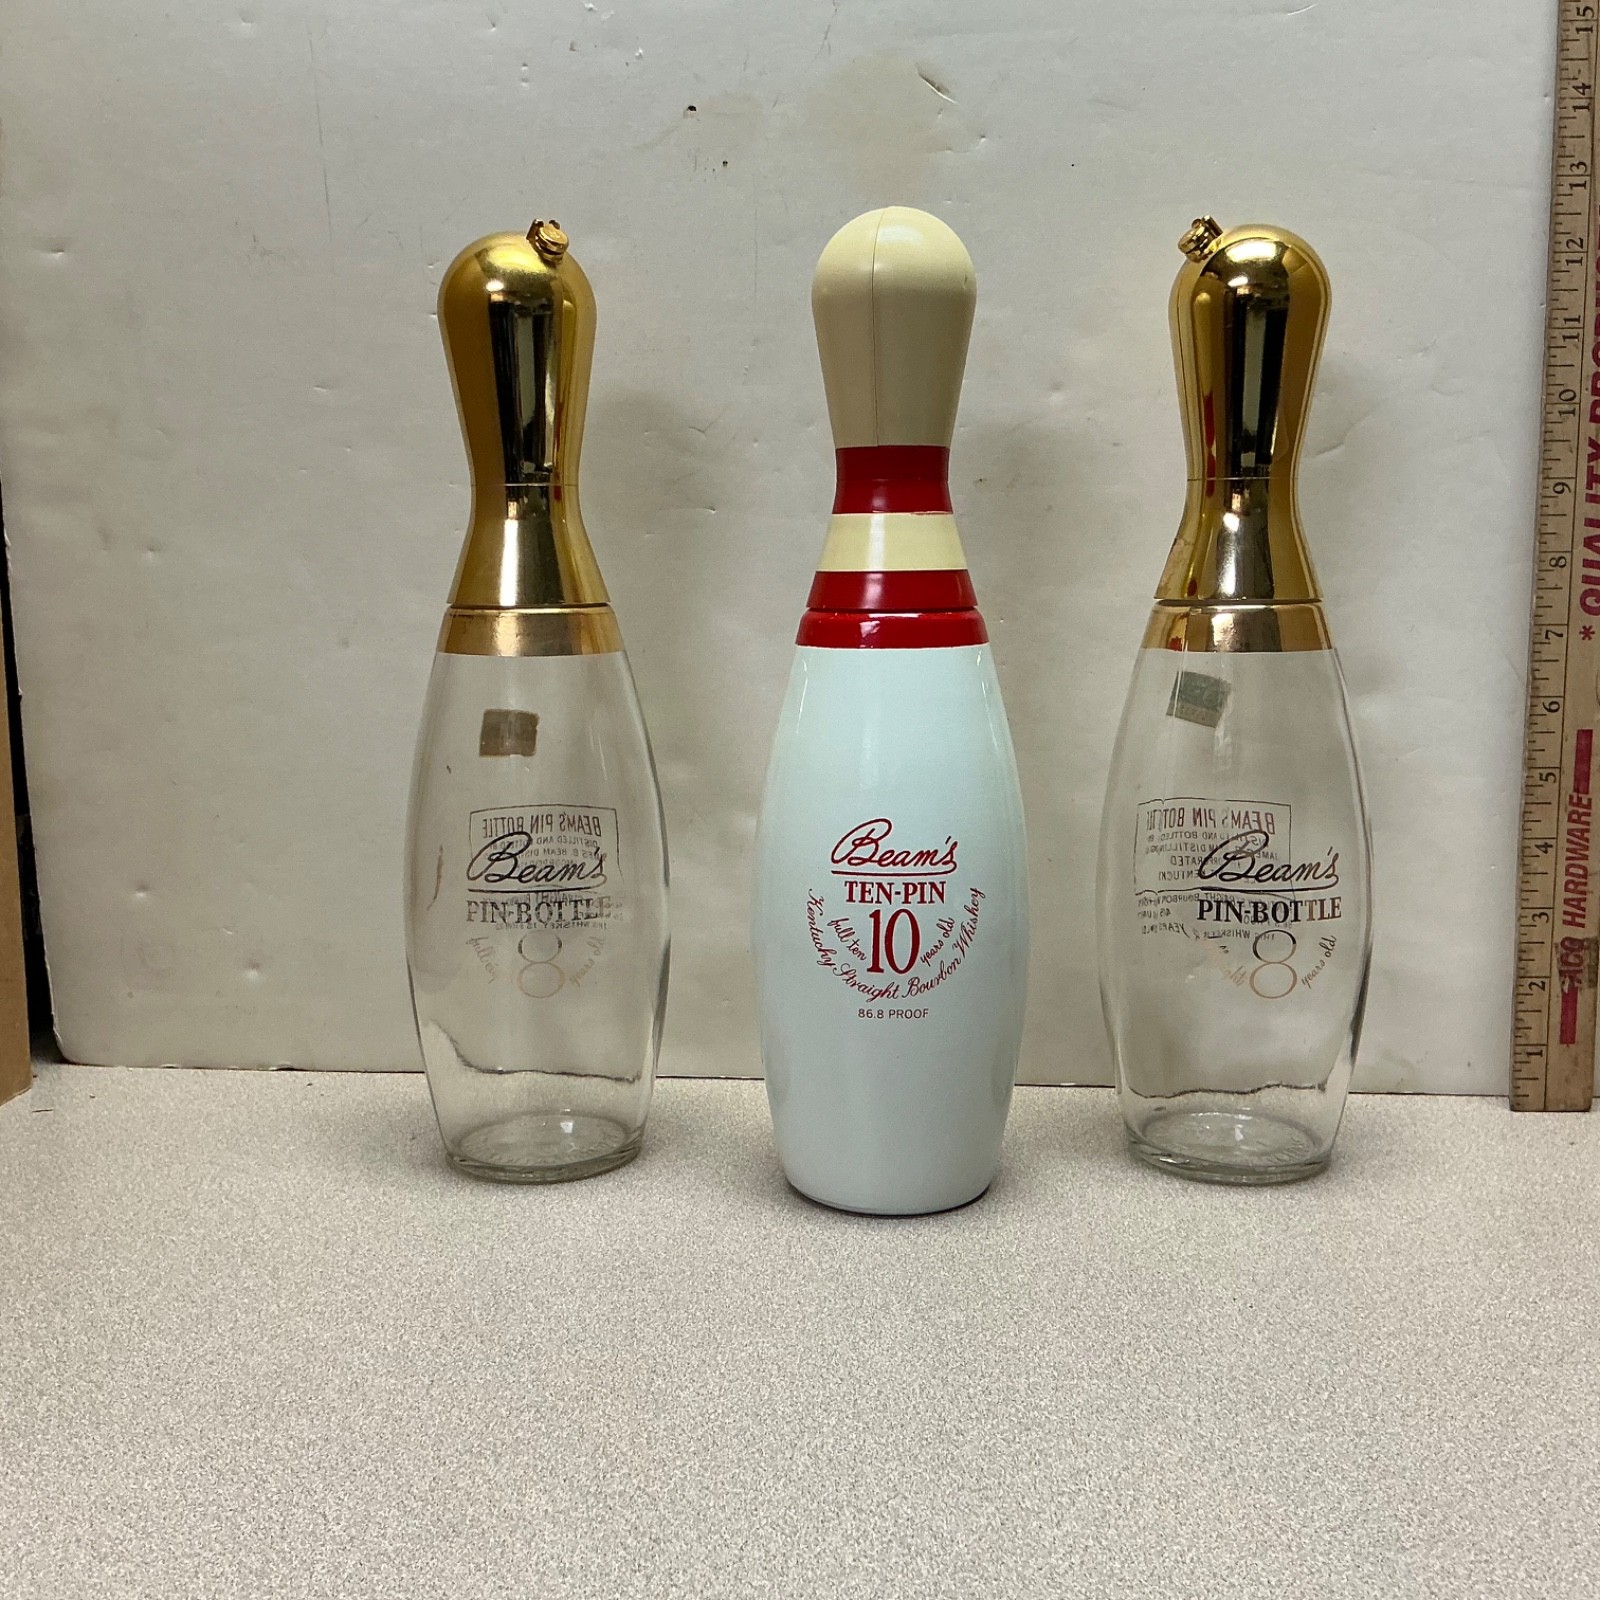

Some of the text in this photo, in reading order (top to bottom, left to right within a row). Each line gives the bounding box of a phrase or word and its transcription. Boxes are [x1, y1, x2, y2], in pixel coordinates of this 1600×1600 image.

[1576, 5, 1595, 35] 15
[1572, 82, 1592, 112] 14
[1569, 161, 1588, 190] 13
[1565, 237, 1584, 267] 12
[1562, 314, 1581, 343] 11
[1558, 388, 1577, 417] 10
[1553, 481, 1571, 495] 9
[1549, 555, 1567, 569] 8
[1545, 628, 1564, 640] 7
[1542, 700, 1560, 713] 6
[1539, 771, 1557, 784] 5
[466, 831, 608, 886] Beam's
[831, 818, 958, 873] Beam's
[1198, 830, 1340, 886] Beam's
[1534, 841, 1554, 855] 4
[1562, 793, 1592, 929] HARDWARE
[844, 881, 947, 906] TEN-PIN
[1197, 896, 1342, 924] PIN-BOTTLE
[1531, 911, 1549, 924] 3
[807, 887, 987, 1002] Kentucky Straight Bourbon Whiskey
[826, 917, 868, 961] full ten
[866, 908, 921, 975] 10
[919, 916, 956, 967] years old
[517, 929, 565, 999] 8
[1249, 929, 1298, 999] 8
[1300, 935, 1338, 989] years old
[1528, 980, 1546, 992] 2
[857, 1007, 930, 1020] 86.8 PROOF
[1525, 1049, 1543, 1058] 1
